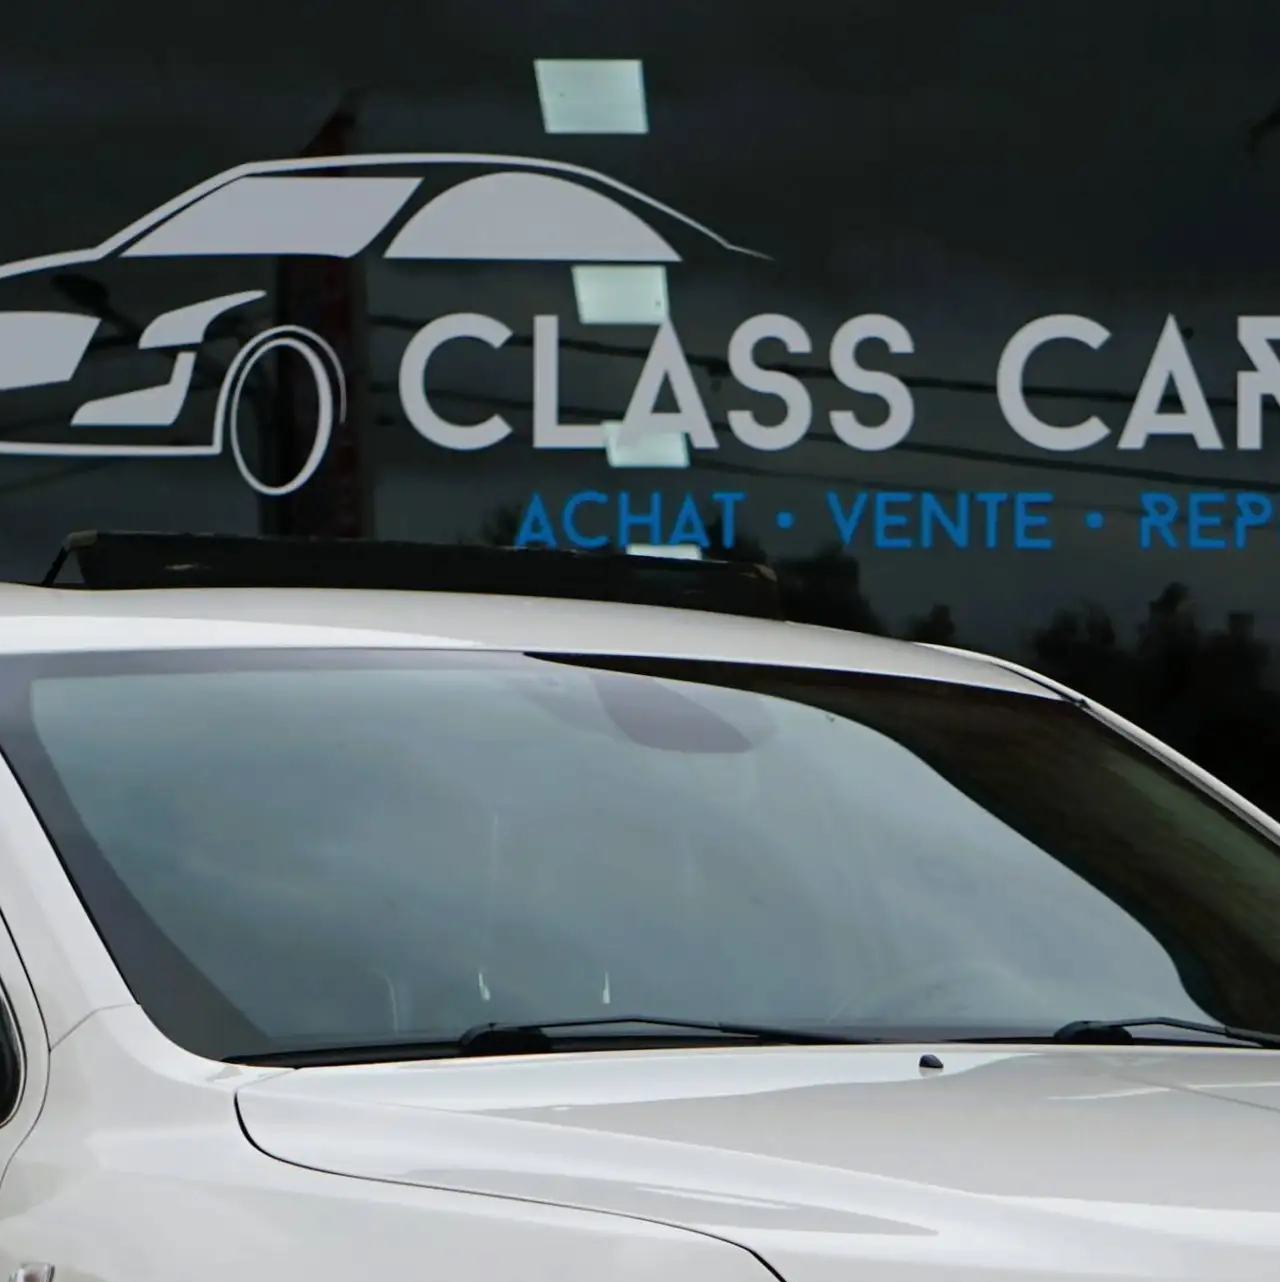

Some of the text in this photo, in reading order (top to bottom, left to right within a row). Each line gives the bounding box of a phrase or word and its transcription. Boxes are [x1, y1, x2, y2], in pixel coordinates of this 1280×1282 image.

[398, 312, 916, 451] CLASS
[515, 491, 747, 549] ACHAT
[826, 491, 1052, 548] VENTE
